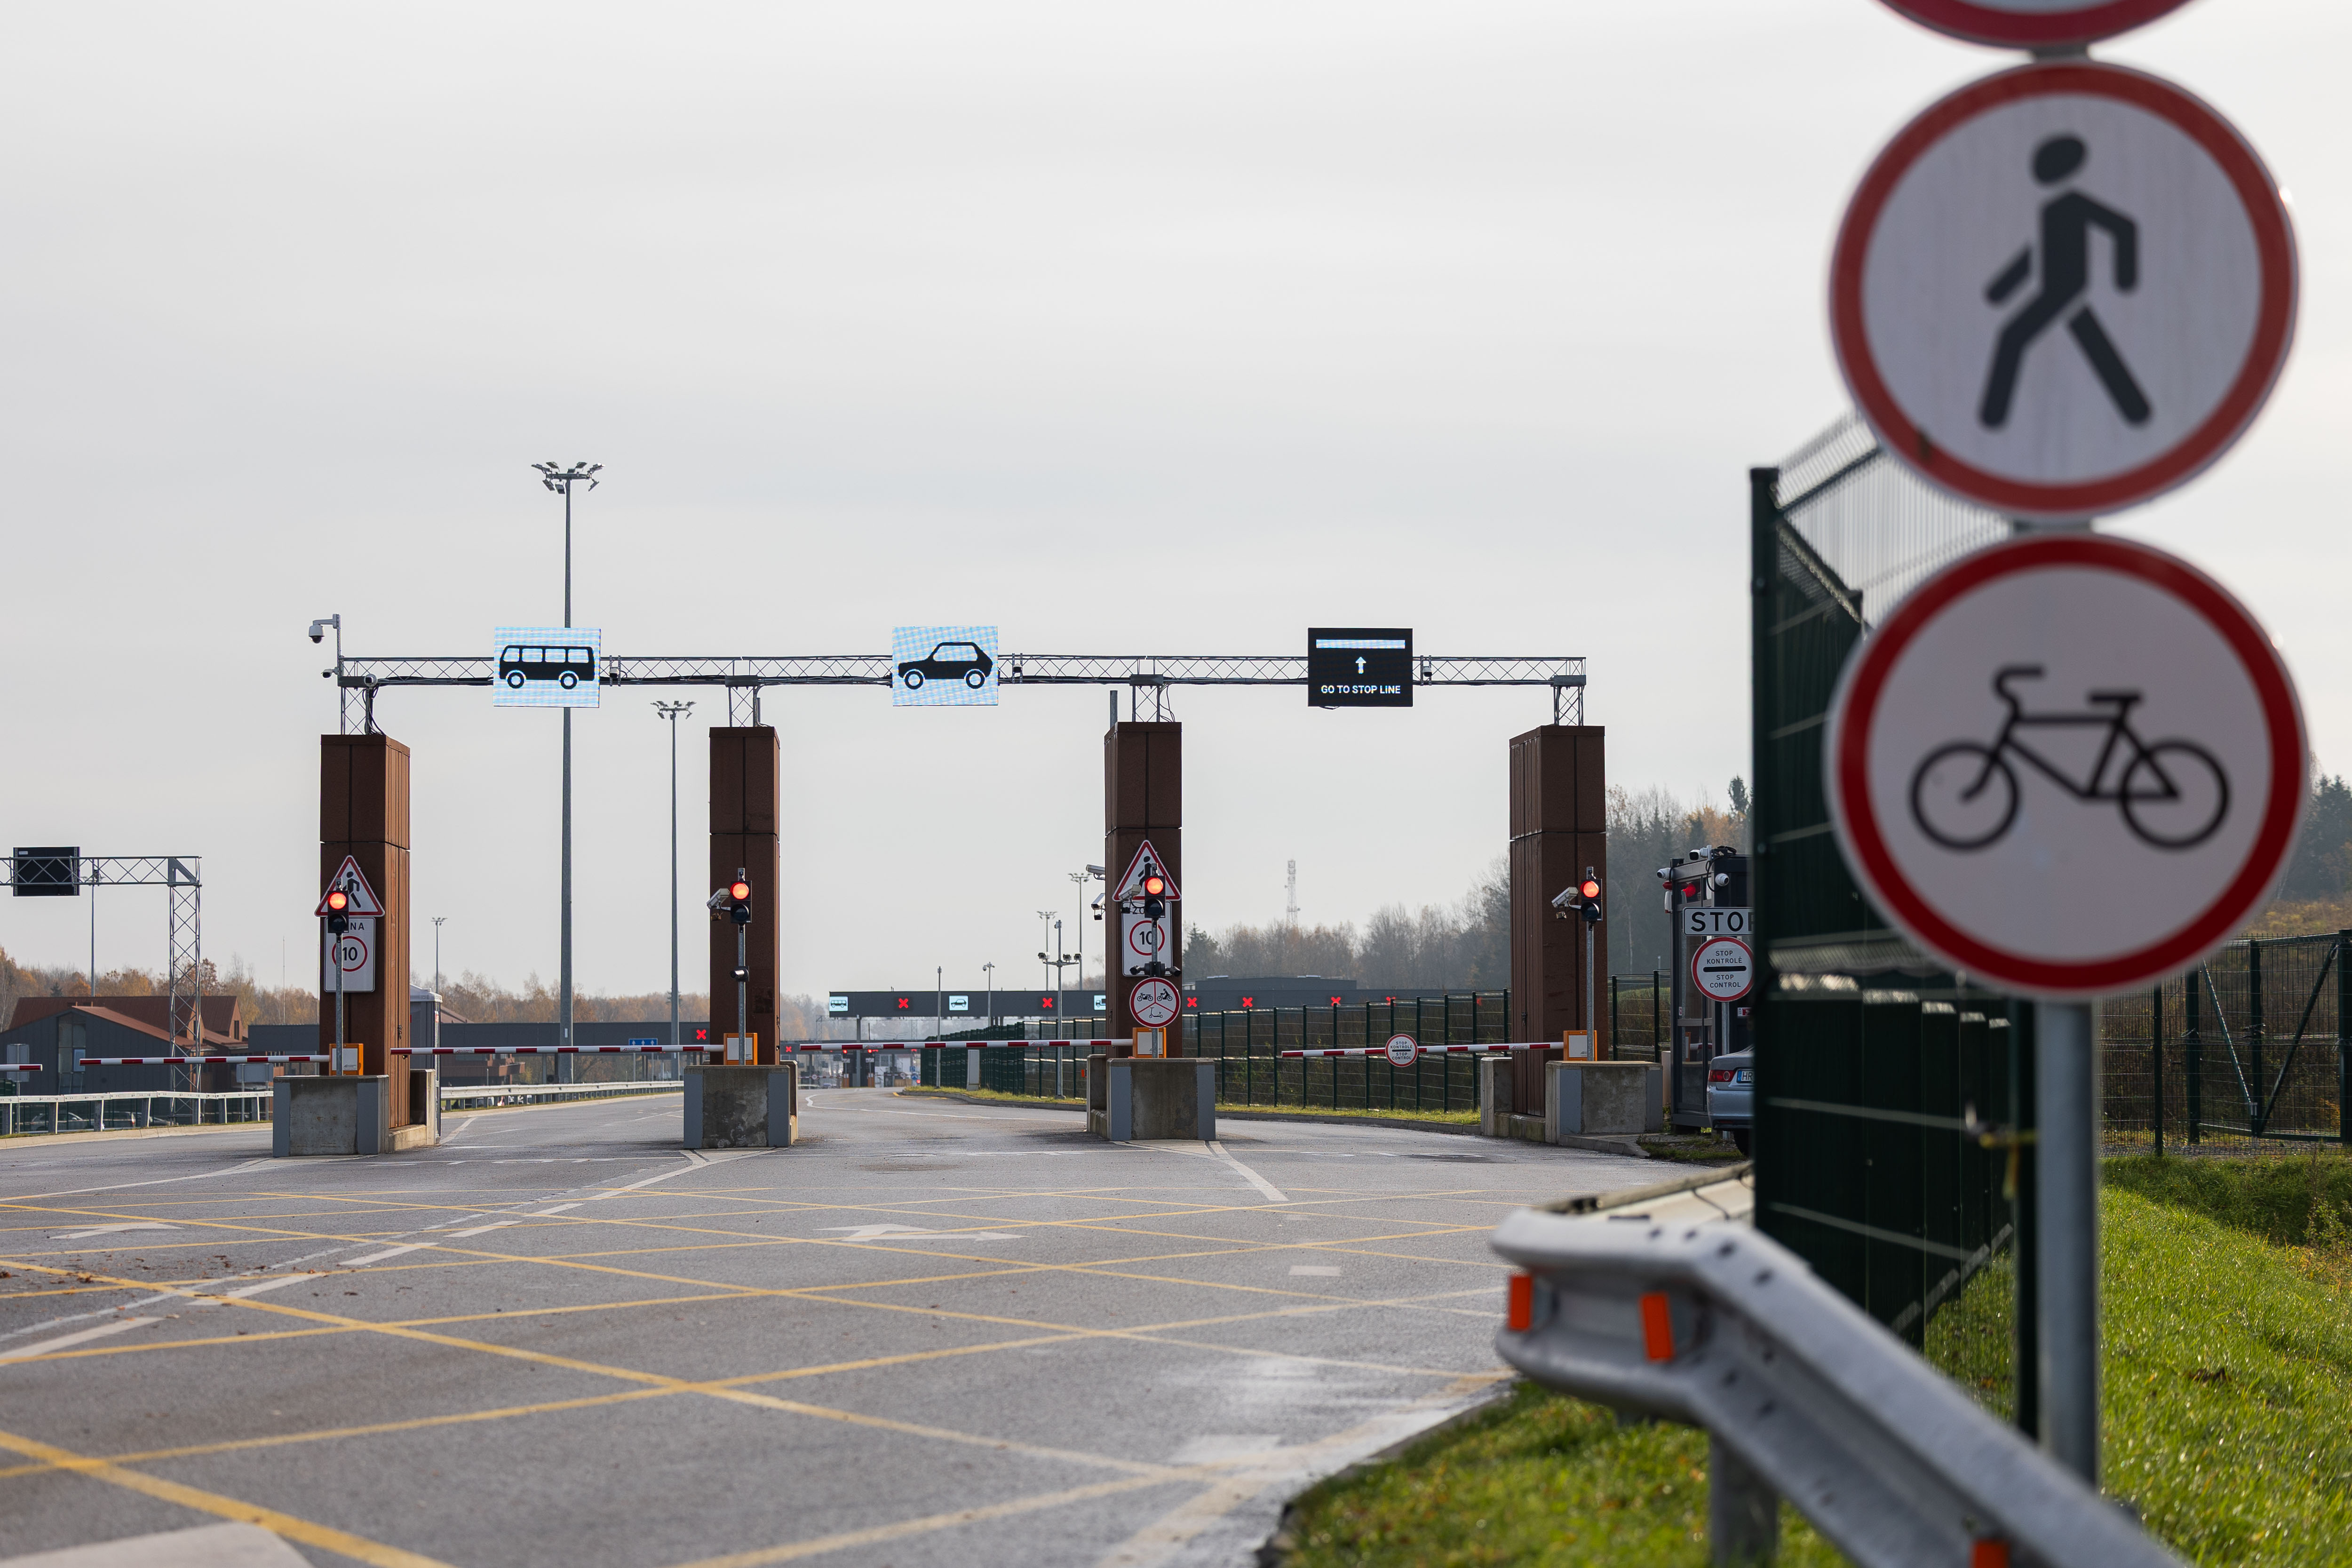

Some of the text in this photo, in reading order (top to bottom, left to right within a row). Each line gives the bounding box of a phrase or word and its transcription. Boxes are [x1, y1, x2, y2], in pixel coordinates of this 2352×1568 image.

[1321, 685, 1401, 694] GO TO STOP LINE
[1139, 931, 1152, 945] 10
[342, 947, 358, 961] 10
